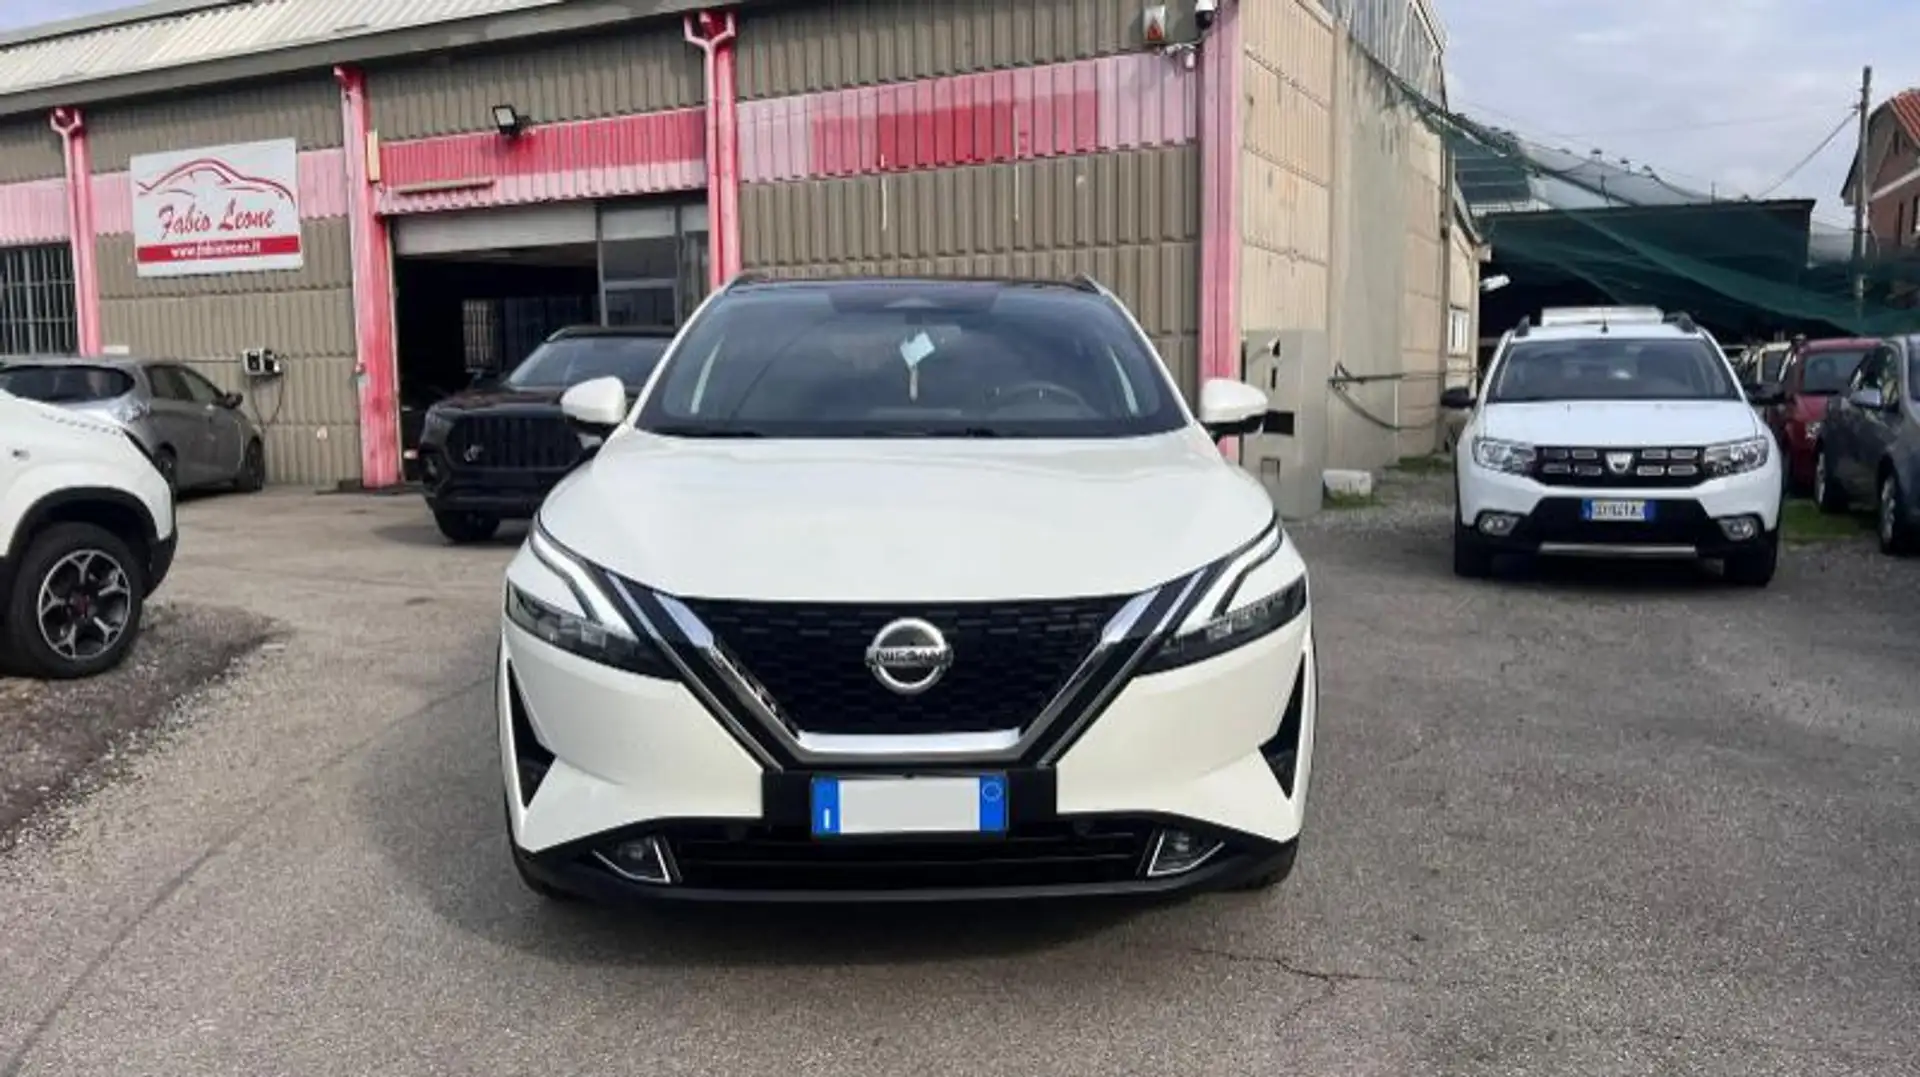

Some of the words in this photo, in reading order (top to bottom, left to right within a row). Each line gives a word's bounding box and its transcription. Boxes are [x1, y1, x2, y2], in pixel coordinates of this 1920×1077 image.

[158, 203, 211, 241] Fabio
[218, 198, 275, 231] Leone
[876, 648, 946, 663] NISSAN
